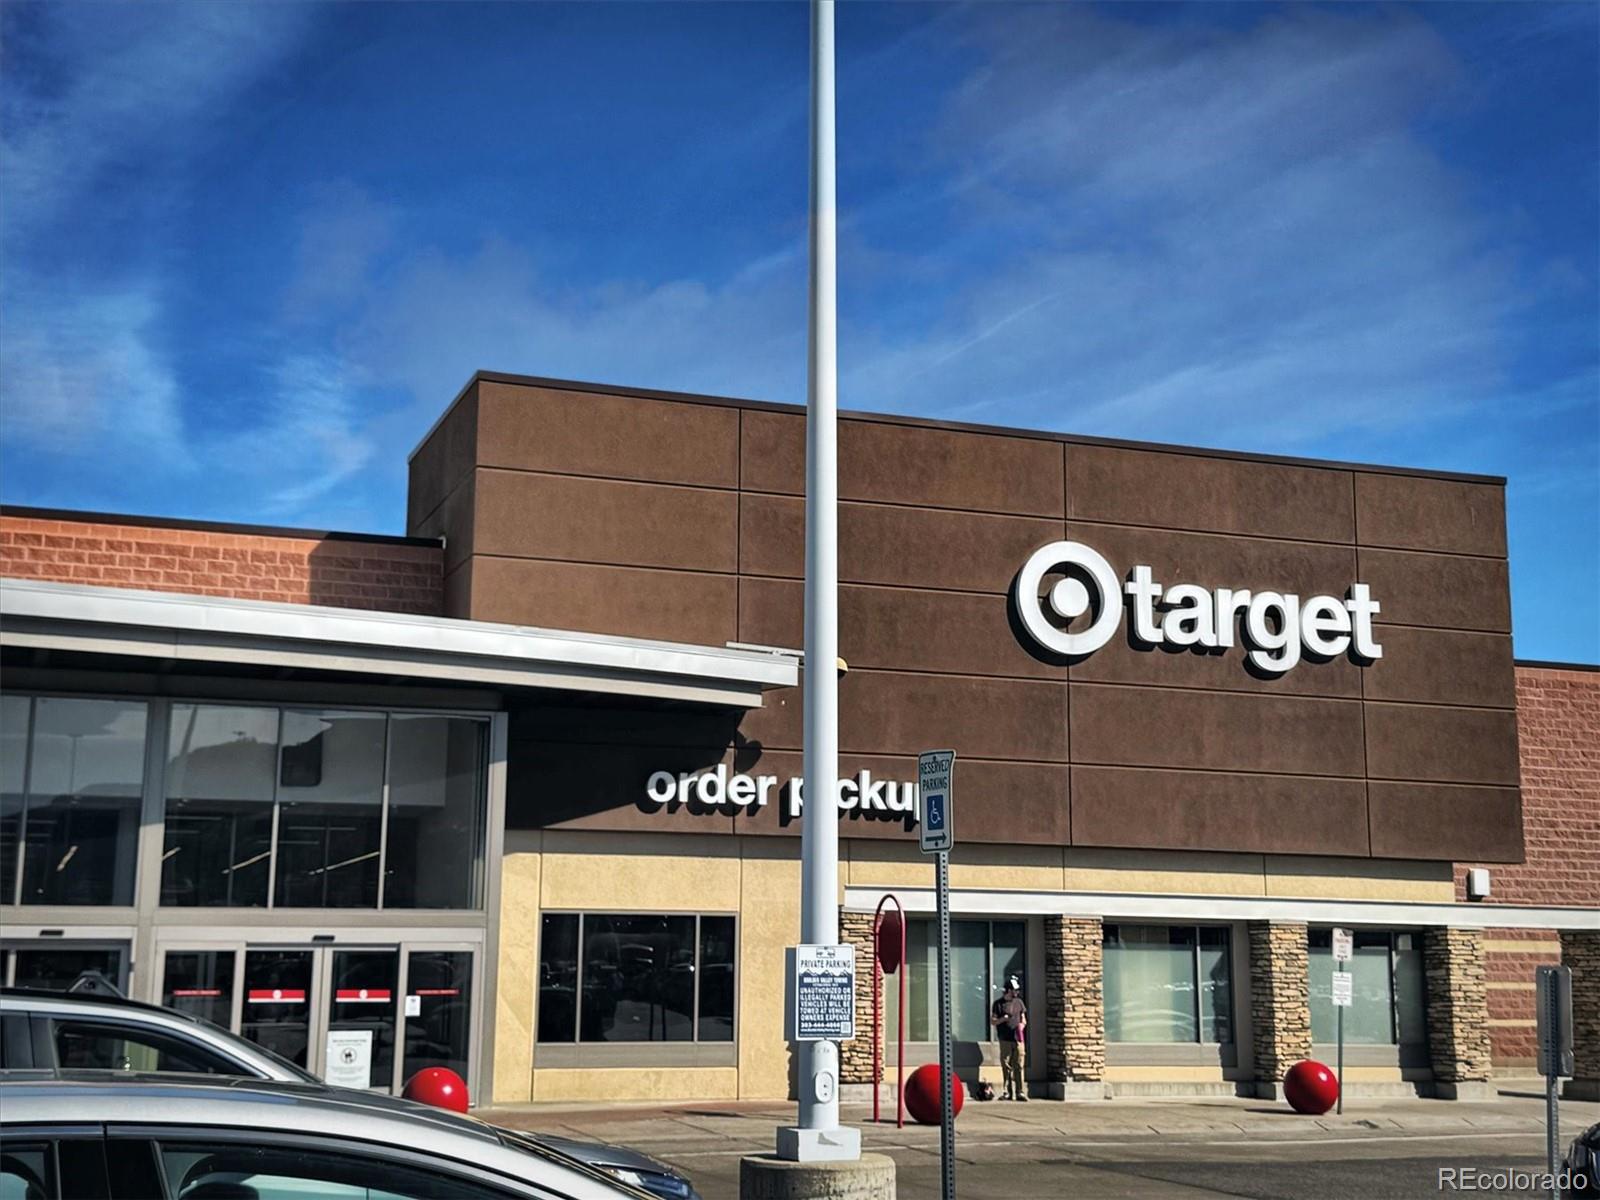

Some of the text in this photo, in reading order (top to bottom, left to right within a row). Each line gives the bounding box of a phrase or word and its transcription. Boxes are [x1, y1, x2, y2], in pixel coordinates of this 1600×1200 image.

[1124, 565, 1383, 672] target
[920, 759, 950, 775] RESERVED
[647, 763, 920, 821] order pcku
[922, 777, 948, 792] PARKING
[800, 960, 851, 968] PRIVATE PARKING
